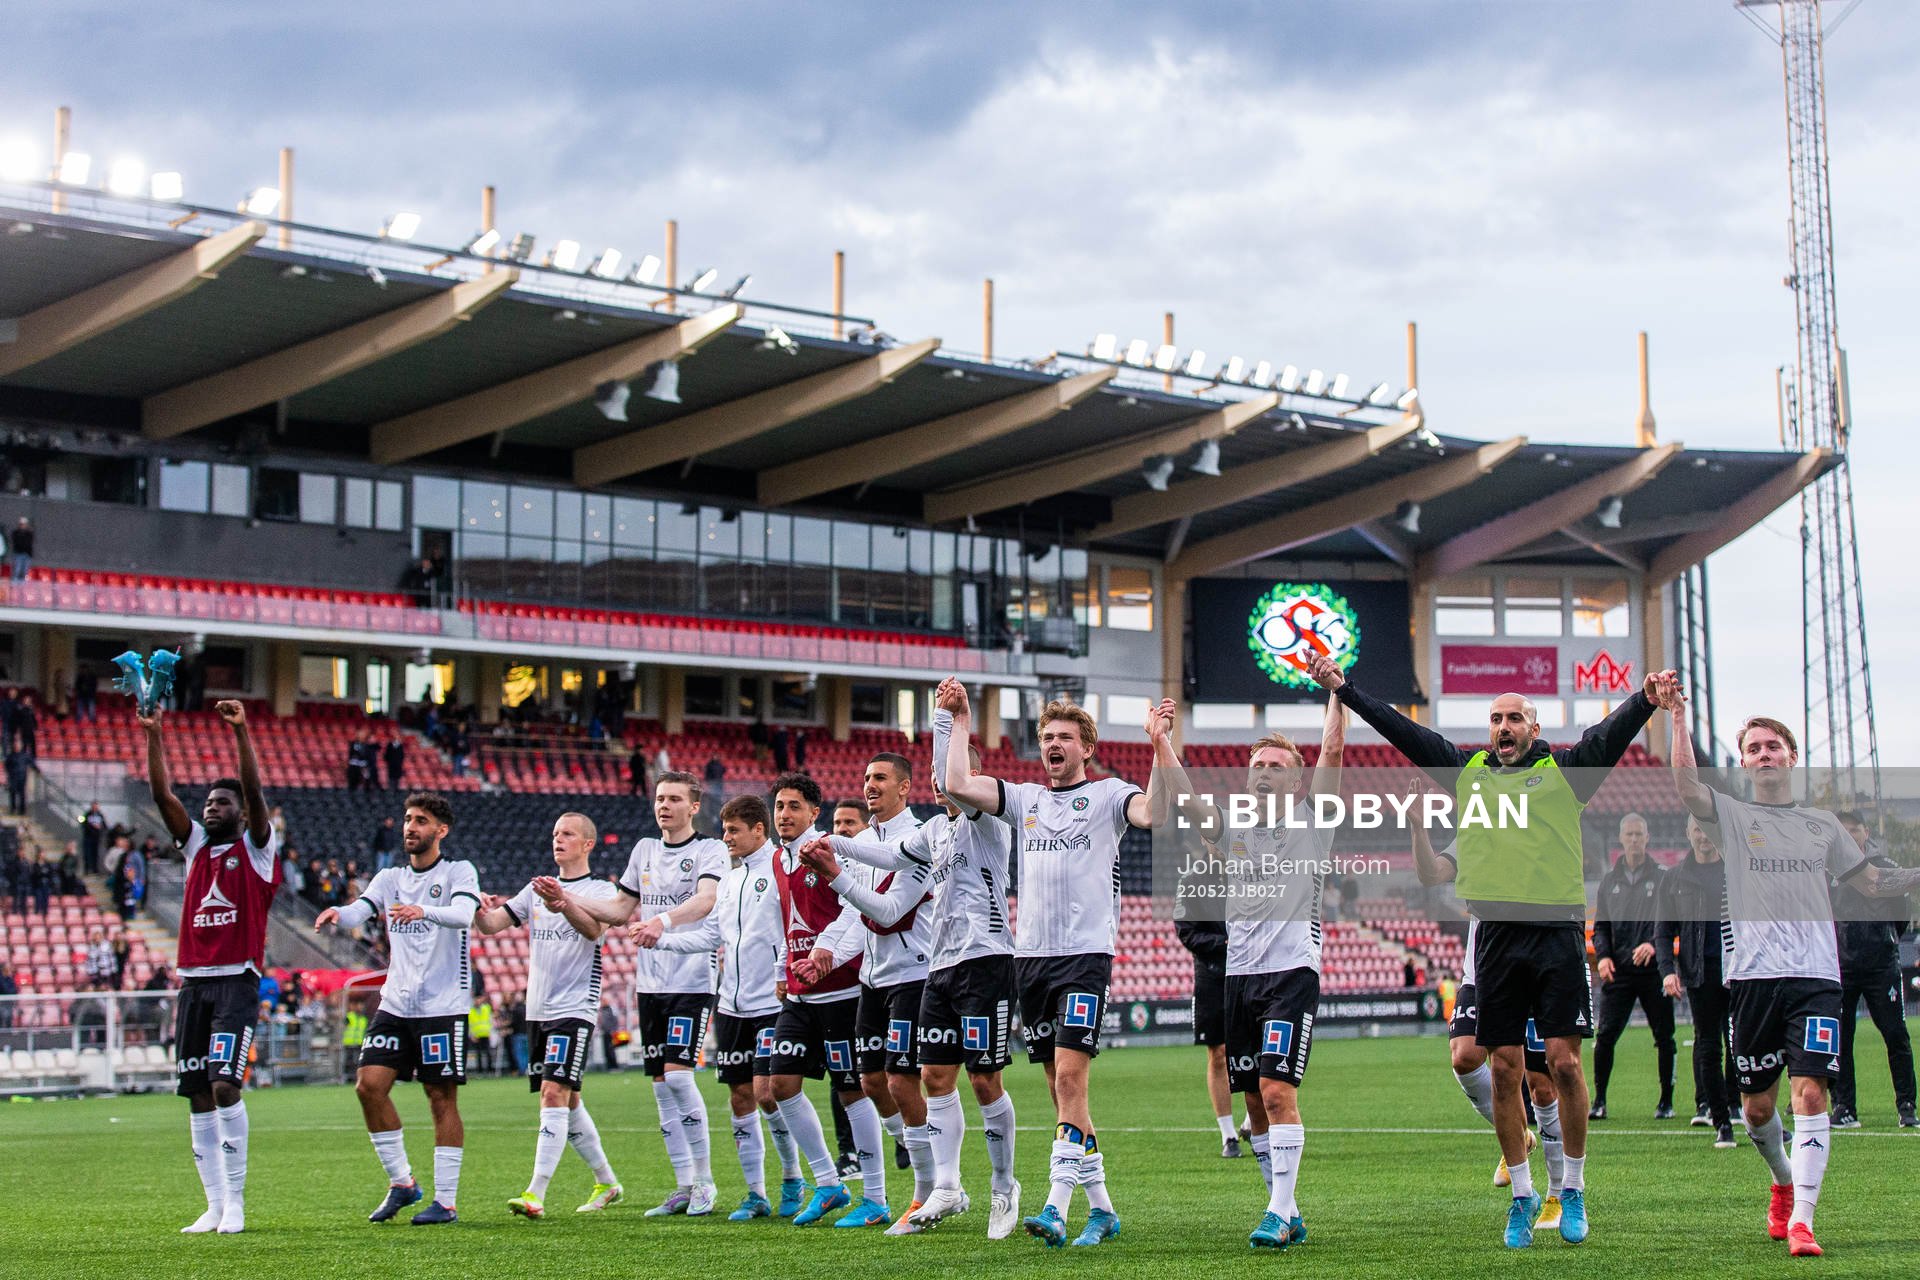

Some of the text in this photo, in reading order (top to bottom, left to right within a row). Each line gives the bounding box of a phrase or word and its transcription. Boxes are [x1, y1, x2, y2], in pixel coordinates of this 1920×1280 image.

[1574, 649, 1634, 695] MAX
[1749, 857, 1812, 873] BEHRN
[193, 909, 238, 928] SELECT
